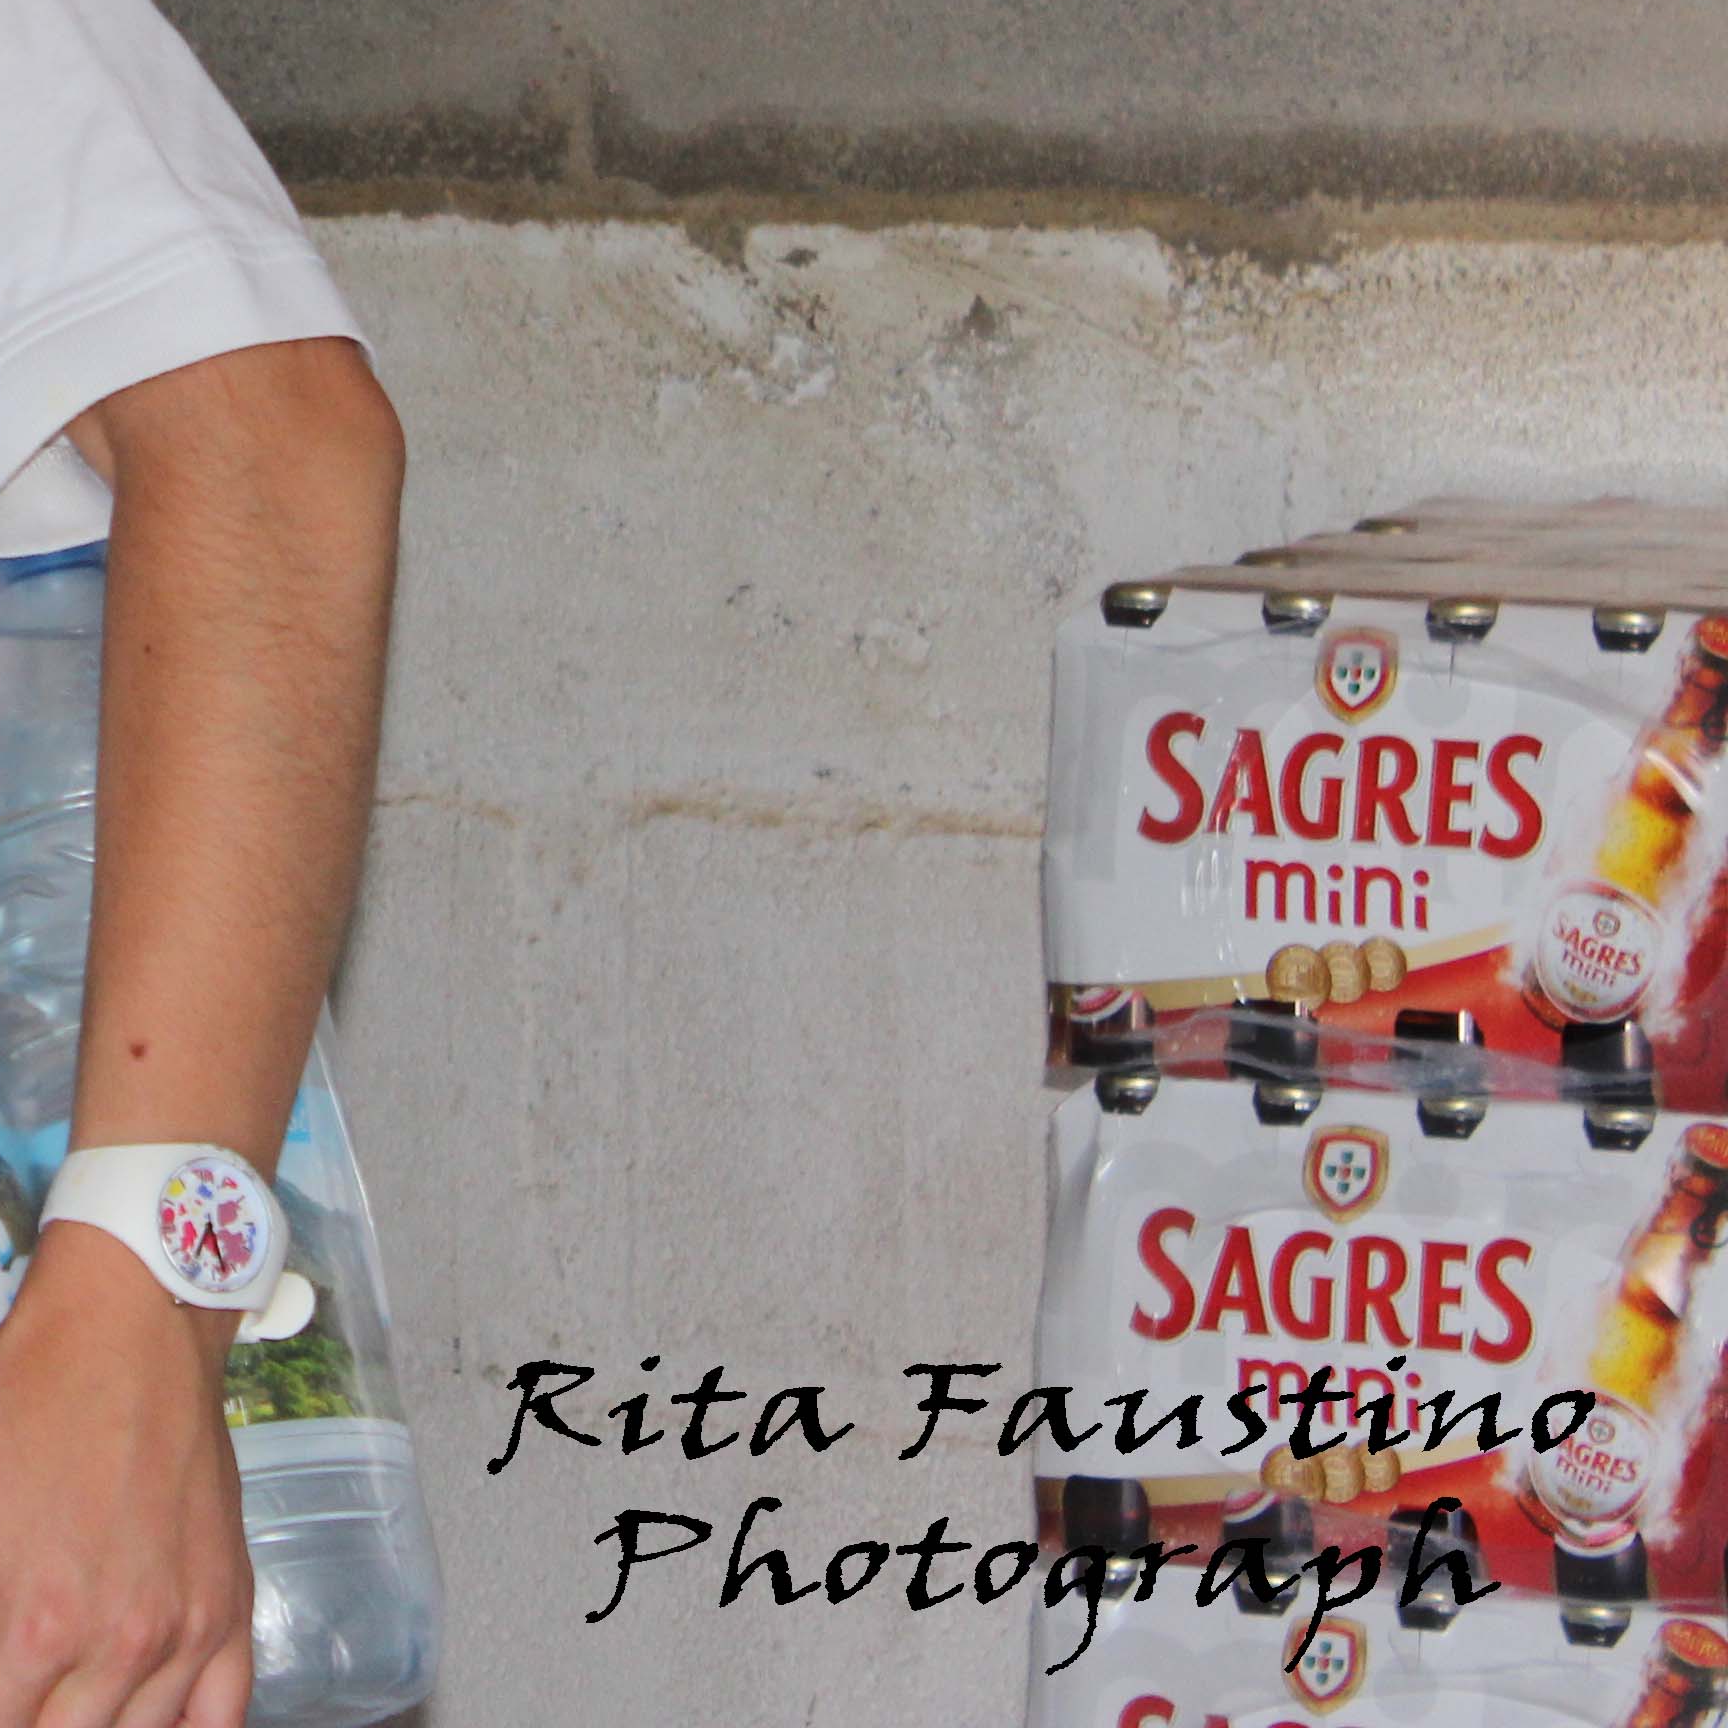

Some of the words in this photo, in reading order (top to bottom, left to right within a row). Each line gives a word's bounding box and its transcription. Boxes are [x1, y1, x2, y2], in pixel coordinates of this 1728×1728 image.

[1136, 710, 1544, 861] SAGRES
[1244, 858, 1430, 931] mini
[1129, 1206, 1536, 1365] SAGRES
